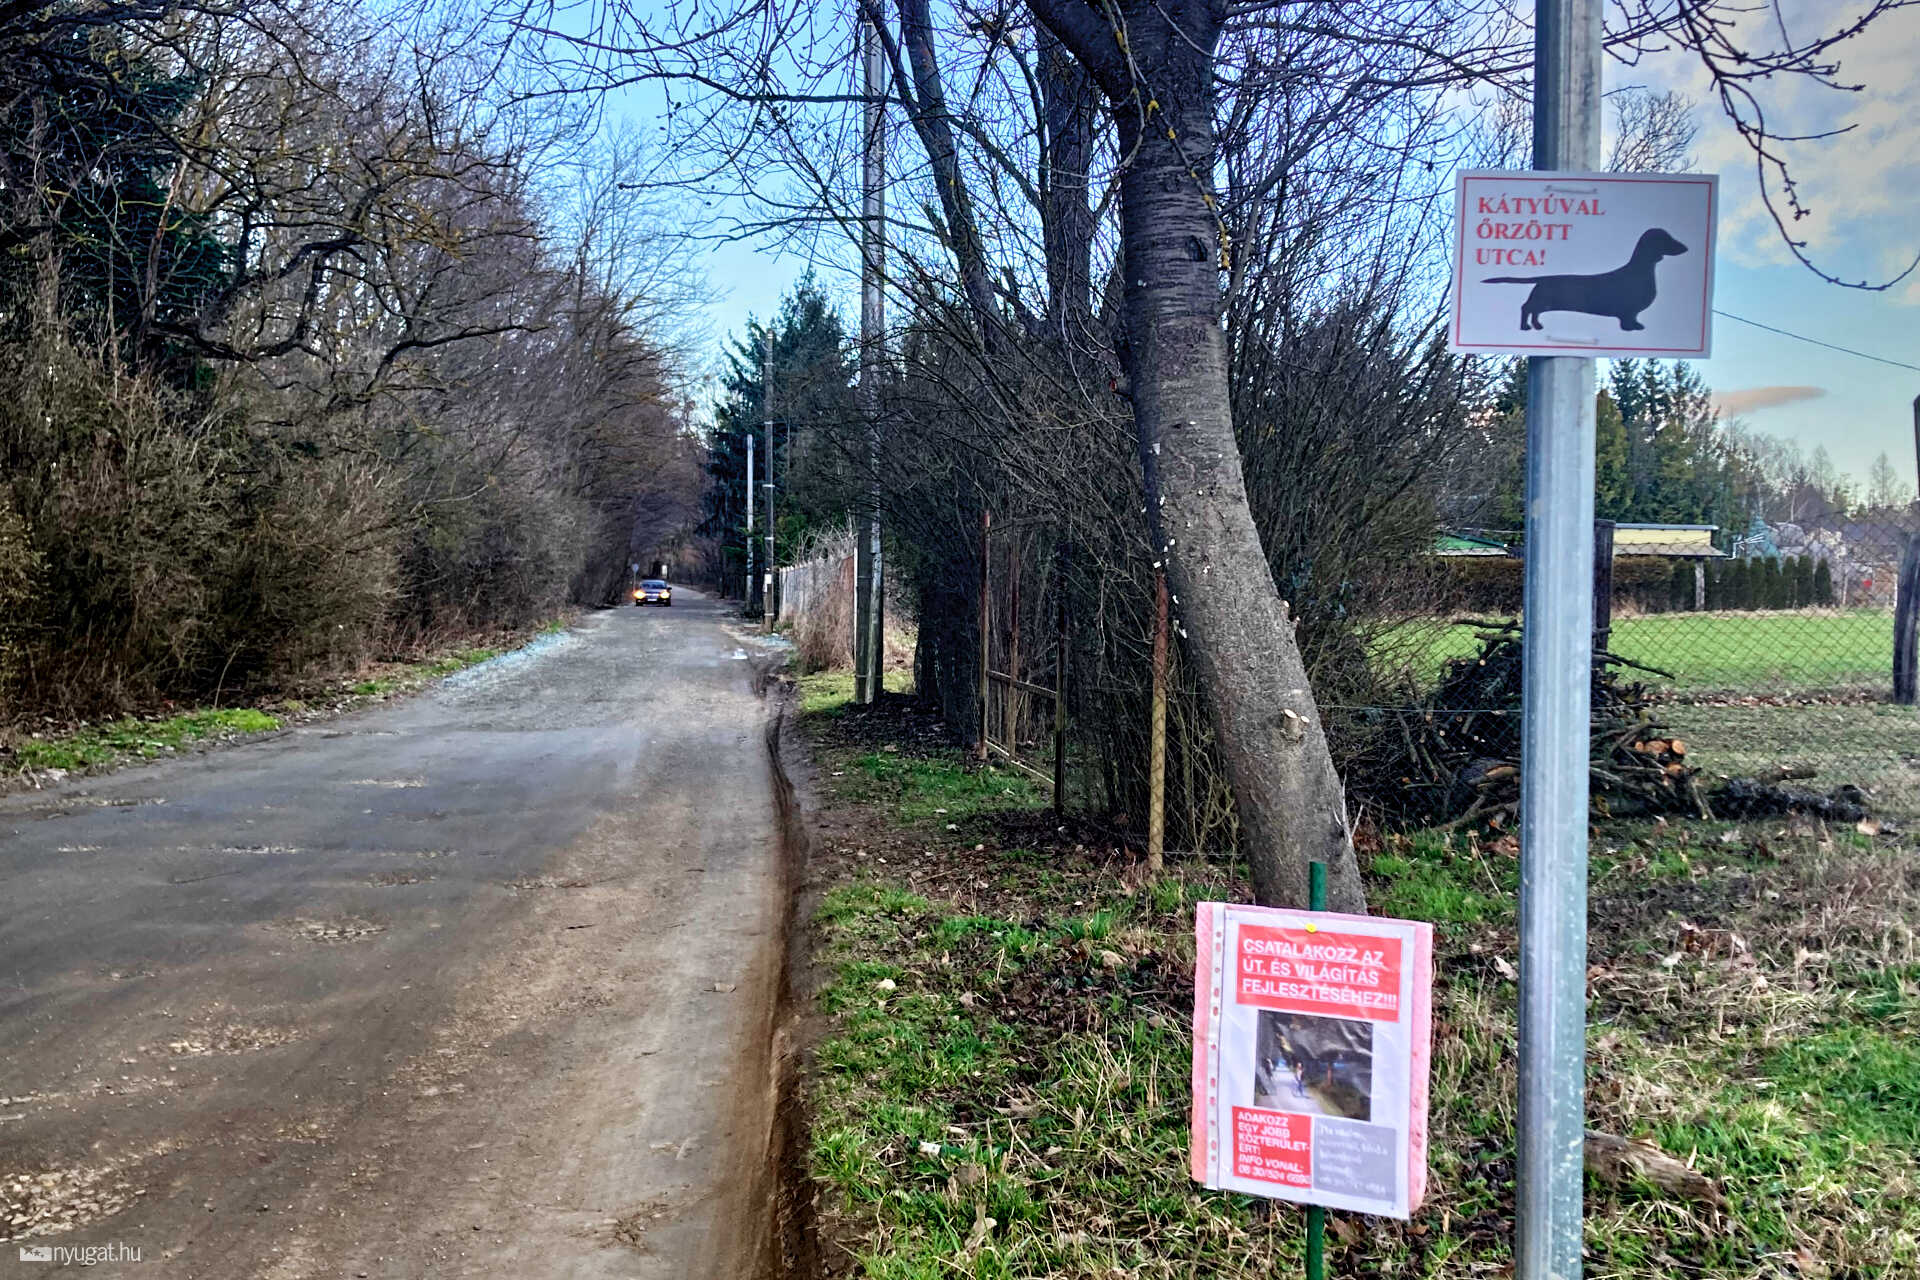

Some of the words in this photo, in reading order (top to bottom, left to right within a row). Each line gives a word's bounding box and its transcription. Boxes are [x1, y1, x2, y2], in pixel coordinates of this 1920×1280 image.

[1478, 192, 1606, 216] KÁTYÚVAL
[1476, 217, 1573, 241] ŐRZÖTT
[1476, 248, 1546, 266] UTCA!
[1243, 938, 1358, 962] CSATALAKOZZ
[1361, 949, 1384, 967] AZ
[1270, 957, 1292, 977] ÉS
[1295, 962, 1379, 986] VILÁGÍTÁS
[1242, 977, 1397, 1009] FEJLESZTÉSÉHEZ!!!
[1238, 1111, 1289, 1127] ADAKOZZ
[1238, 1121, 1259, 1133] EGY
[1261, 1126, 1291, 1138] JOBB
[1238, 1153, 1263, 1166] INFO
